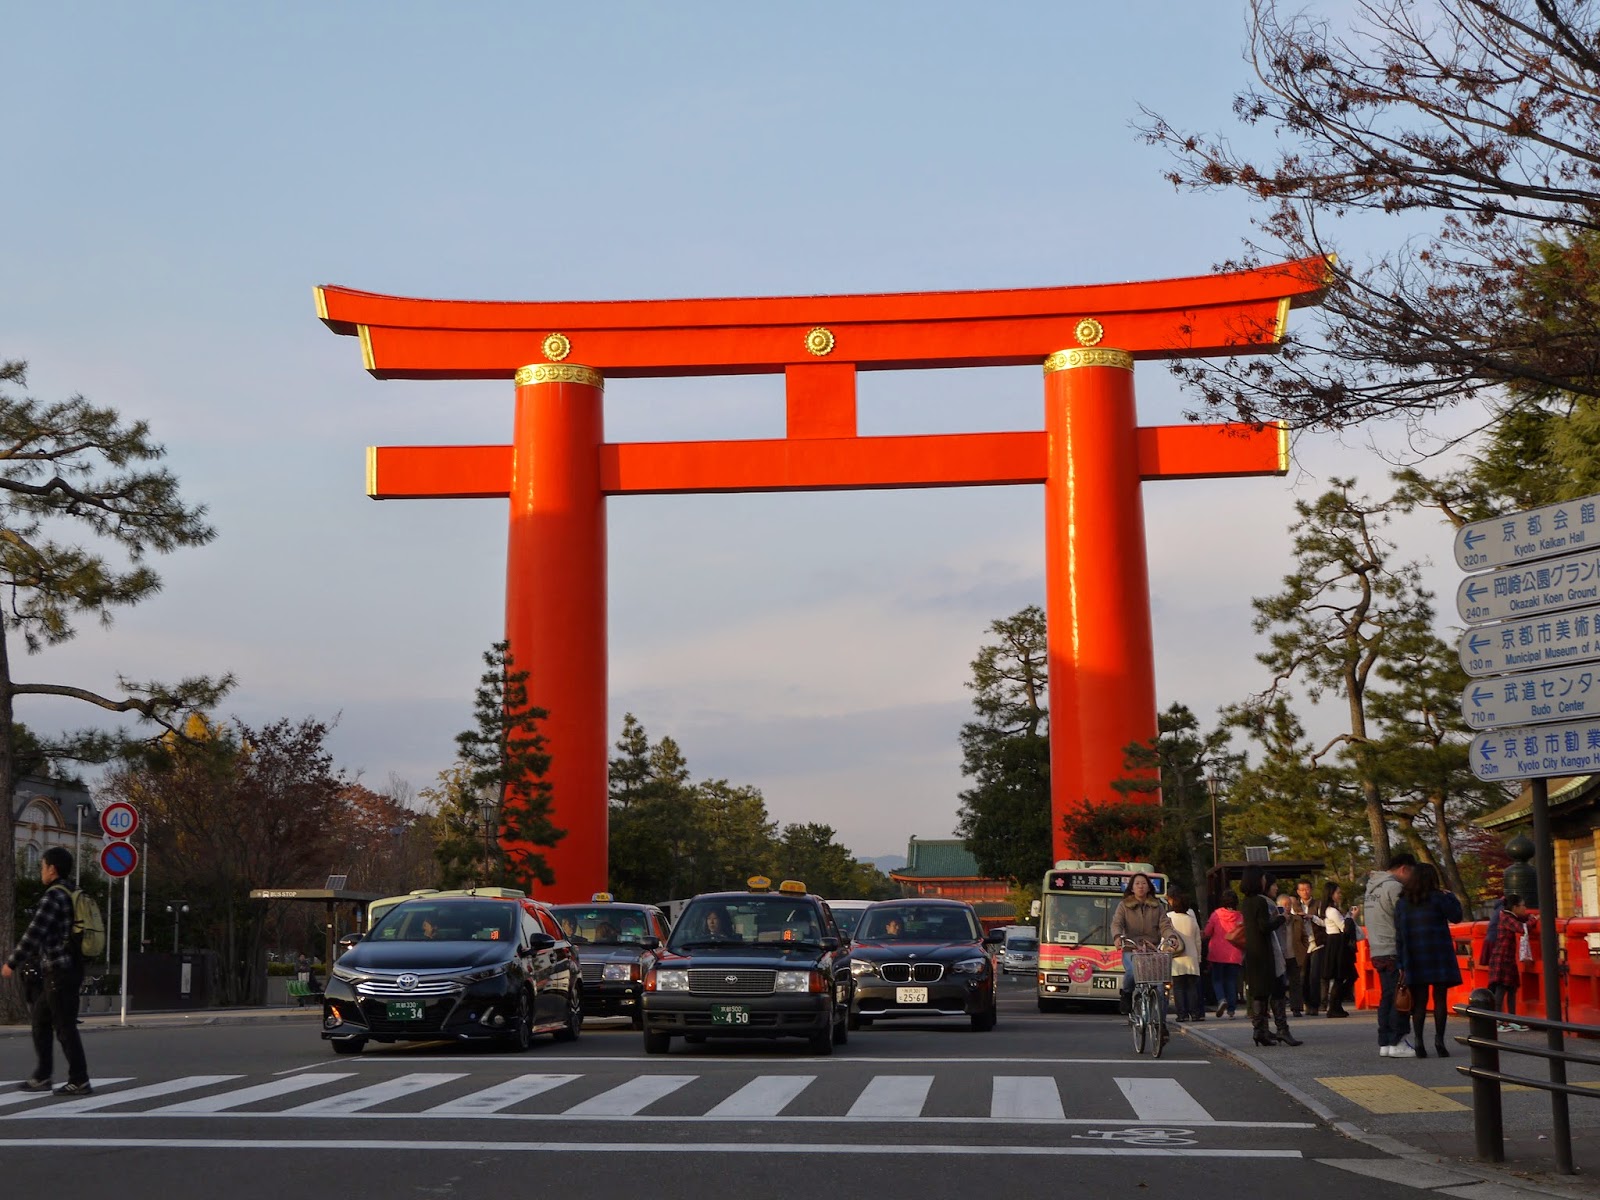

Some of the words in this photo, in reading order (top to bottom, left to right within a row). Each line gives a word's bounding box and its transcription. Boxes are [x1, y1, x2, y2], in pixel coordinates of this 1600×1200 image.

[1502, 503, 1595, 542] 京都会館
[1514, 544, 1536, 557] Kyoto
[1540, 537, 1565, 550] Kaikan
[1569, 531, 1585, 543] Hall
[1510, 595, 1540, 611] Okazaki
[1544, 592, 1564, 604] Koen
[1568, 586, 1597, 600] Ground
[1505, 650, 1541, 665] Municipal
[1545, 645, 1577, 659] Museum
[1582, 642, 1590, 653] of
[1469, 659, 1483, 671] 130
[1485, 659, 1493, 668] m
[1531, 704, 1551, 716] Budo
[1558, 700, 1585, 713] Center
[1472, 712, 1485, 723] 710
[1487, 713, 1495, 721] m
[1480, 764, 1499, 775] 250m
[1518, 759, 1540, 773] Kyoto
[1543, 757, 1558, 770] City
[1561, 753, 1590, 768] Kangyo
[110, 812, 130, 828] 40
[1087, 875, 1120, 886] 京都駅
[1097, 980, 1115, 989] 14-41
[903, 994, 926, 1002] 25-67
